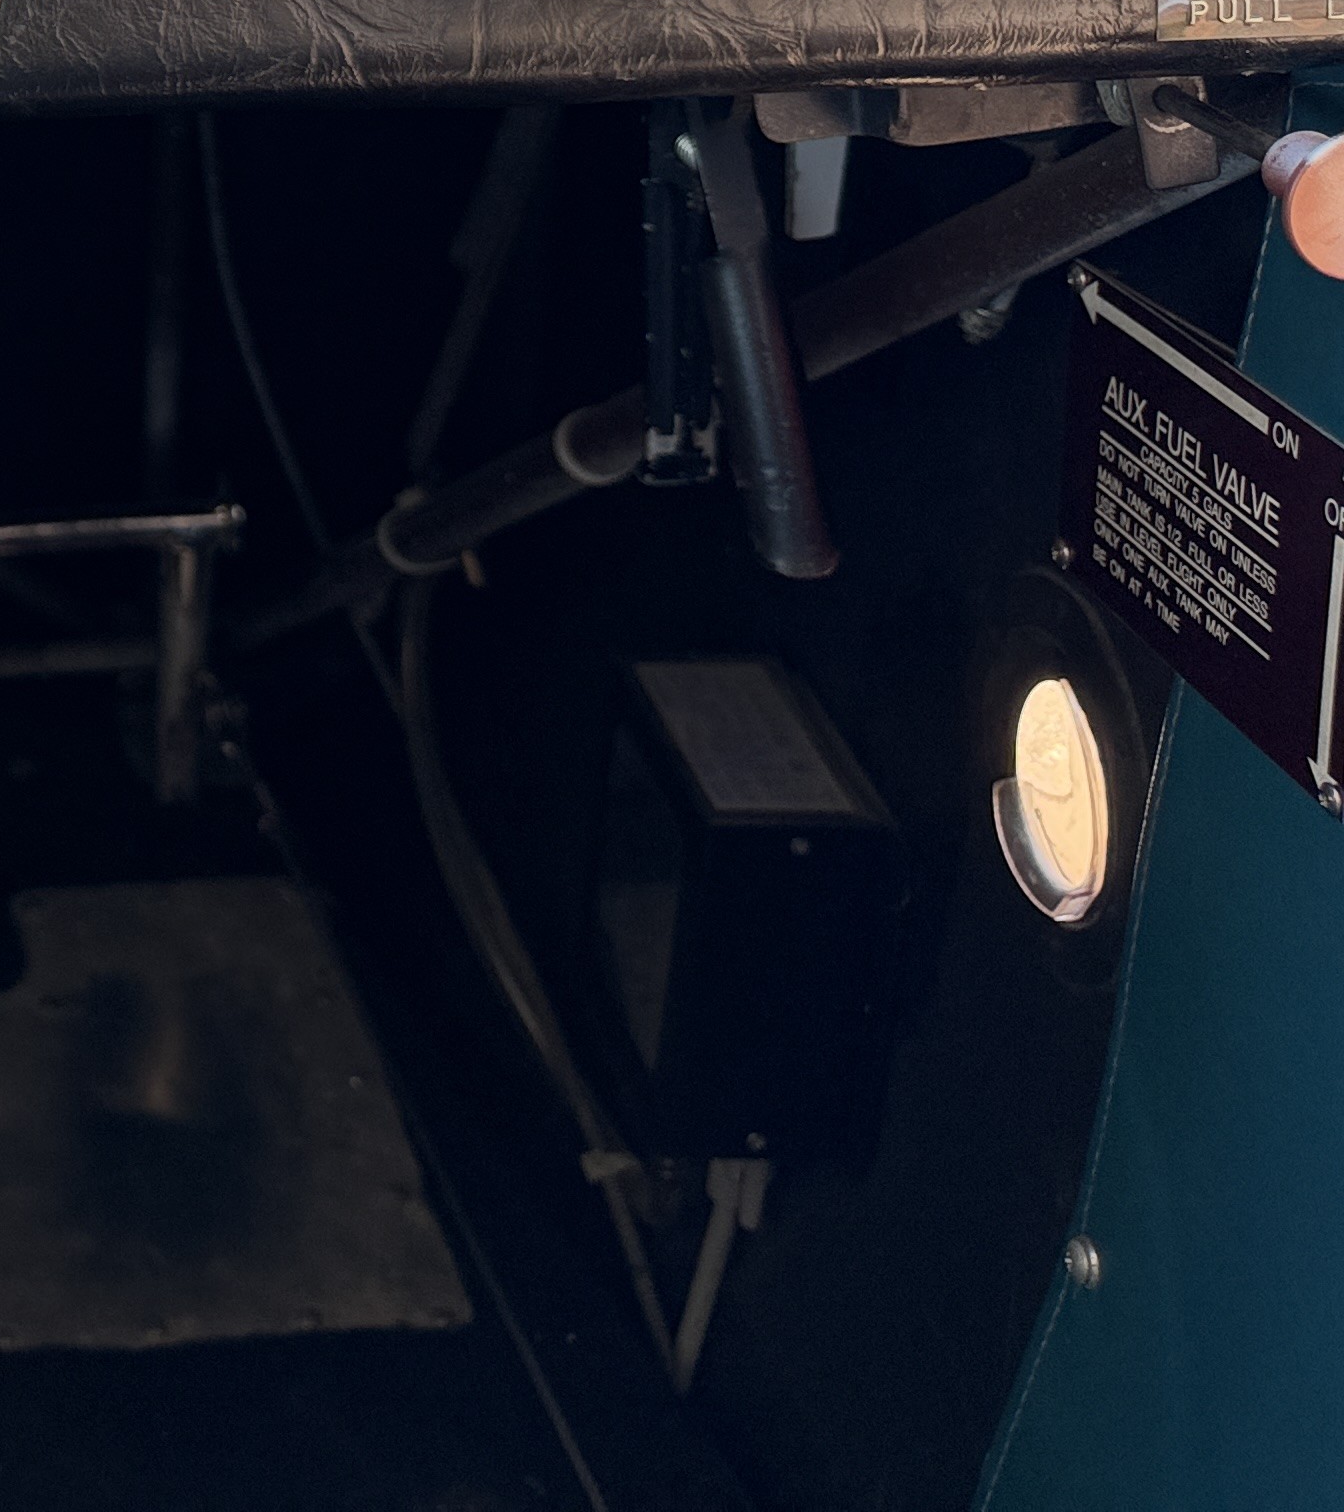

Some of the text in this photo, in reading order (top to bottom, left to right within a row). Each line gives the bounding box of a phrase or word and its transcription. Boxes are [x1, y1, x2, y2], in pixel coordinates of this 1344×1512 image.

[1104, 376, 1281, 536] AUX. FUEL VALVE
[1273, 421, 1299, 460] ON
